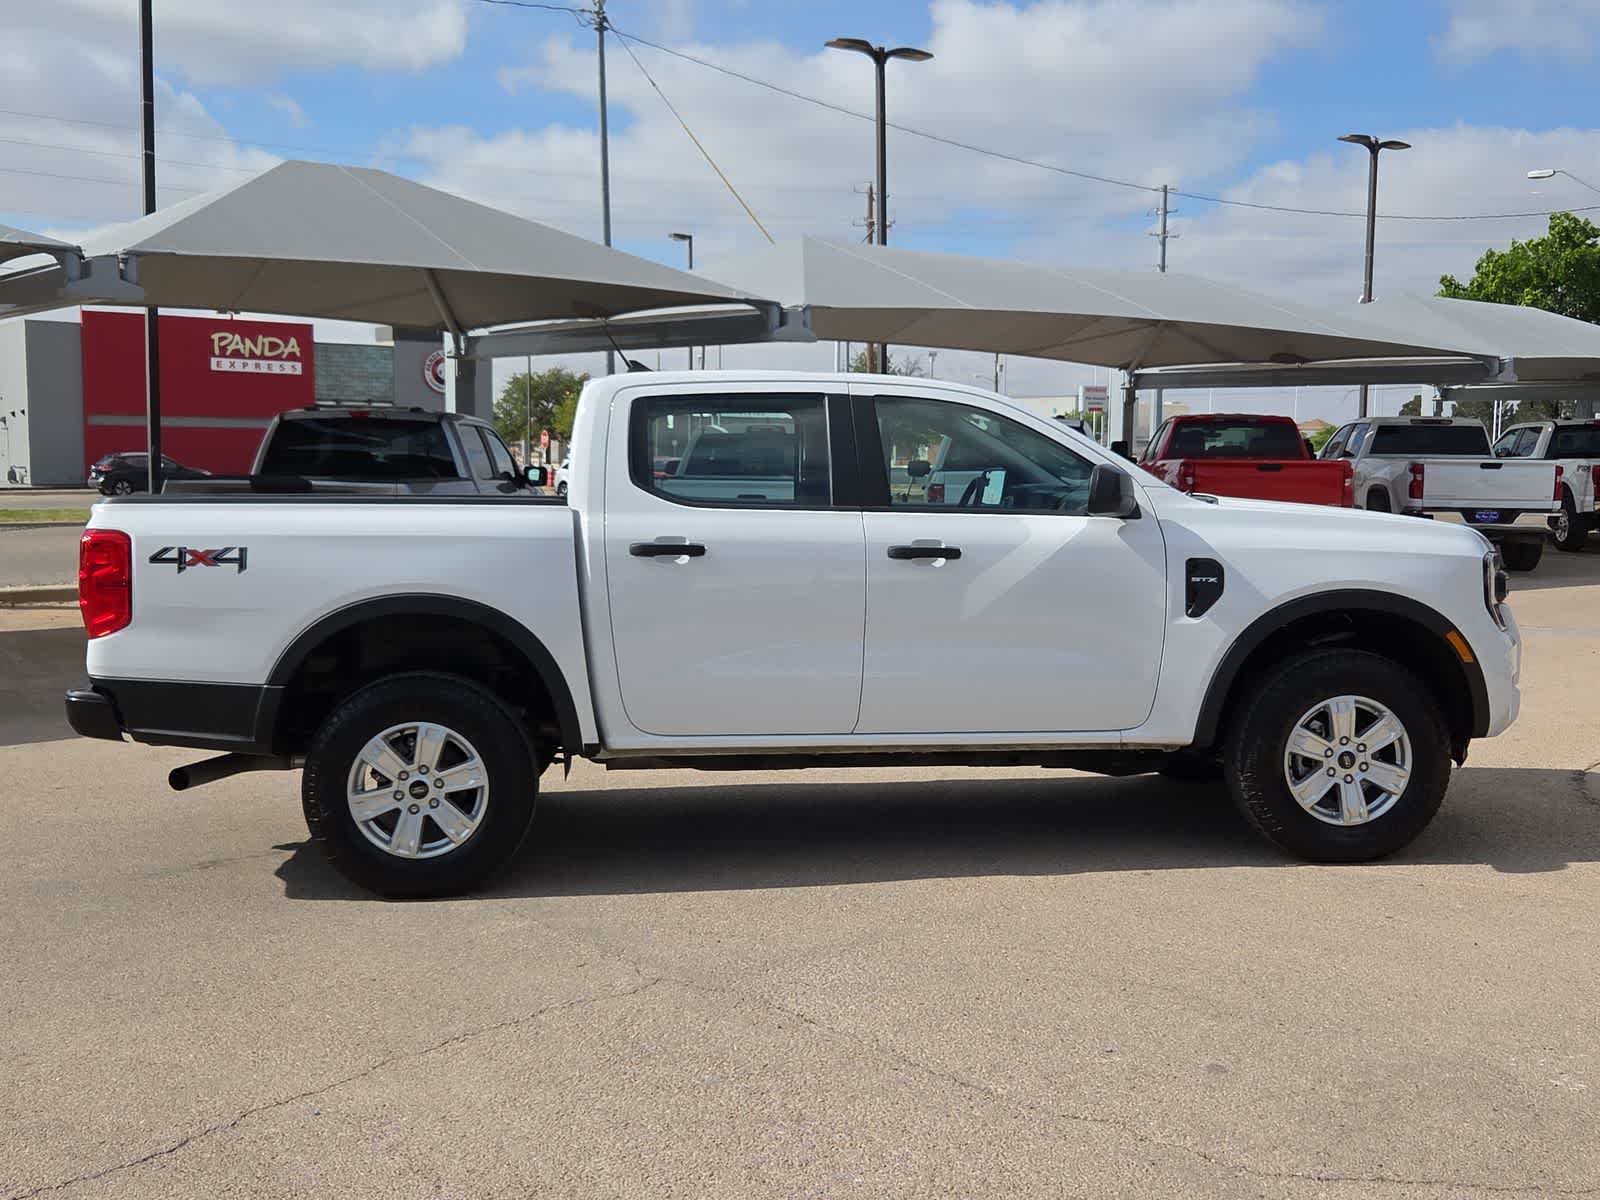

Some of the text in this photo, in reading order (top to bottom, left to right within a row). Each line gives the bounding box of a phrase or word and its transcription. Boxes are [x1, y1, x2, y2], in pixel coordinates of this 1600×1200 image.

[210, 331, 301, 359] PANDA
[215, 360, 298, 373] EXPRESS
[1191, 576, 1218, 584] STX
